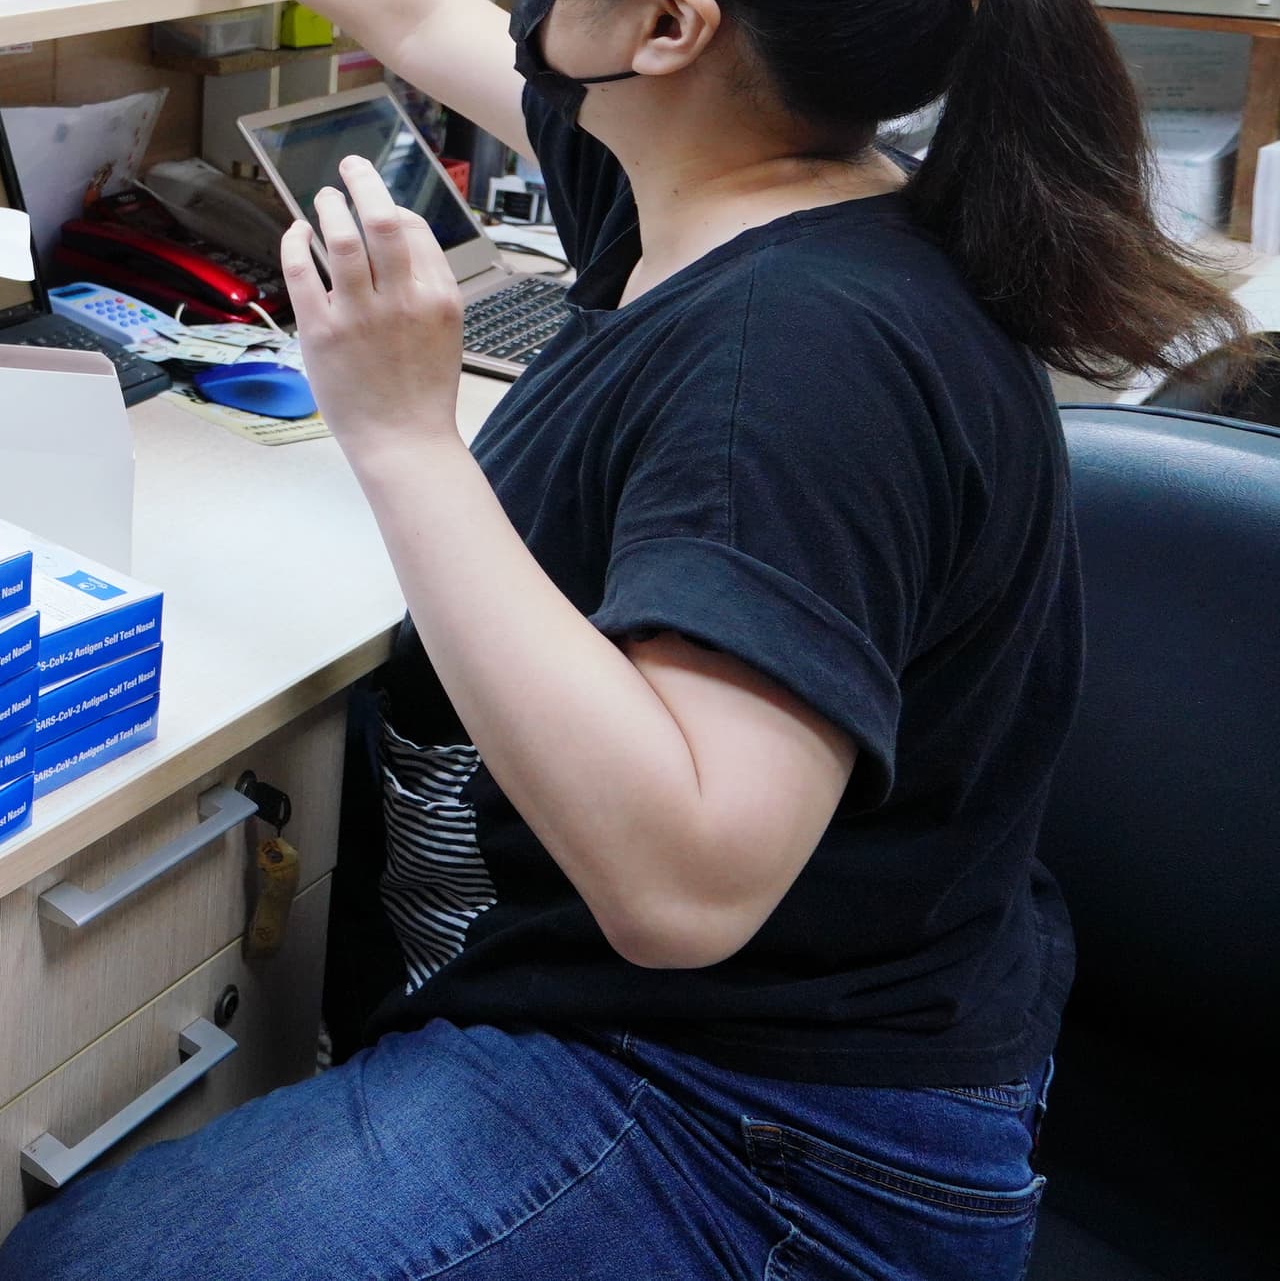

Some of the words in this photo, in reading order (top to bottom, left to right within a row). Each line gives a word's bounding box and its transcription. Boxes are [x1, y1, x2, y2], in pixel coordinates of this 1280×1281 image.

[2, 581, 24, 599] Nasal
[12, 640, 32, 660] Nasal
[38, 652, 73, 672] S-CoV-2
[74, 640, 103, 659] Antigen
[104, 631, 119, 647] Self
[119, 625, 135, 641] Test
[136, 618, 155, 635] Nasal
[11, 695, 31, 715] Nasal
[36, 704, 81, 733] SARS-CoV-2
[82, 691, 108, 711] Antigen
[109, 681, 123, 699] Self
[123, 675, 138, 692] Test
[138, 668, 156, 686] Nasal
[4, 747, 26, 767] Nasal
[33, 755, 78, 785] SARS-CoV-2
[79, 742, 105, 763] Antigen
[105, 732, 119, 750] Self
[119, 725, 134, 742] Test
[134, 717, 152, 735] Nasal
[7, 802, 27, 823] Nasal
